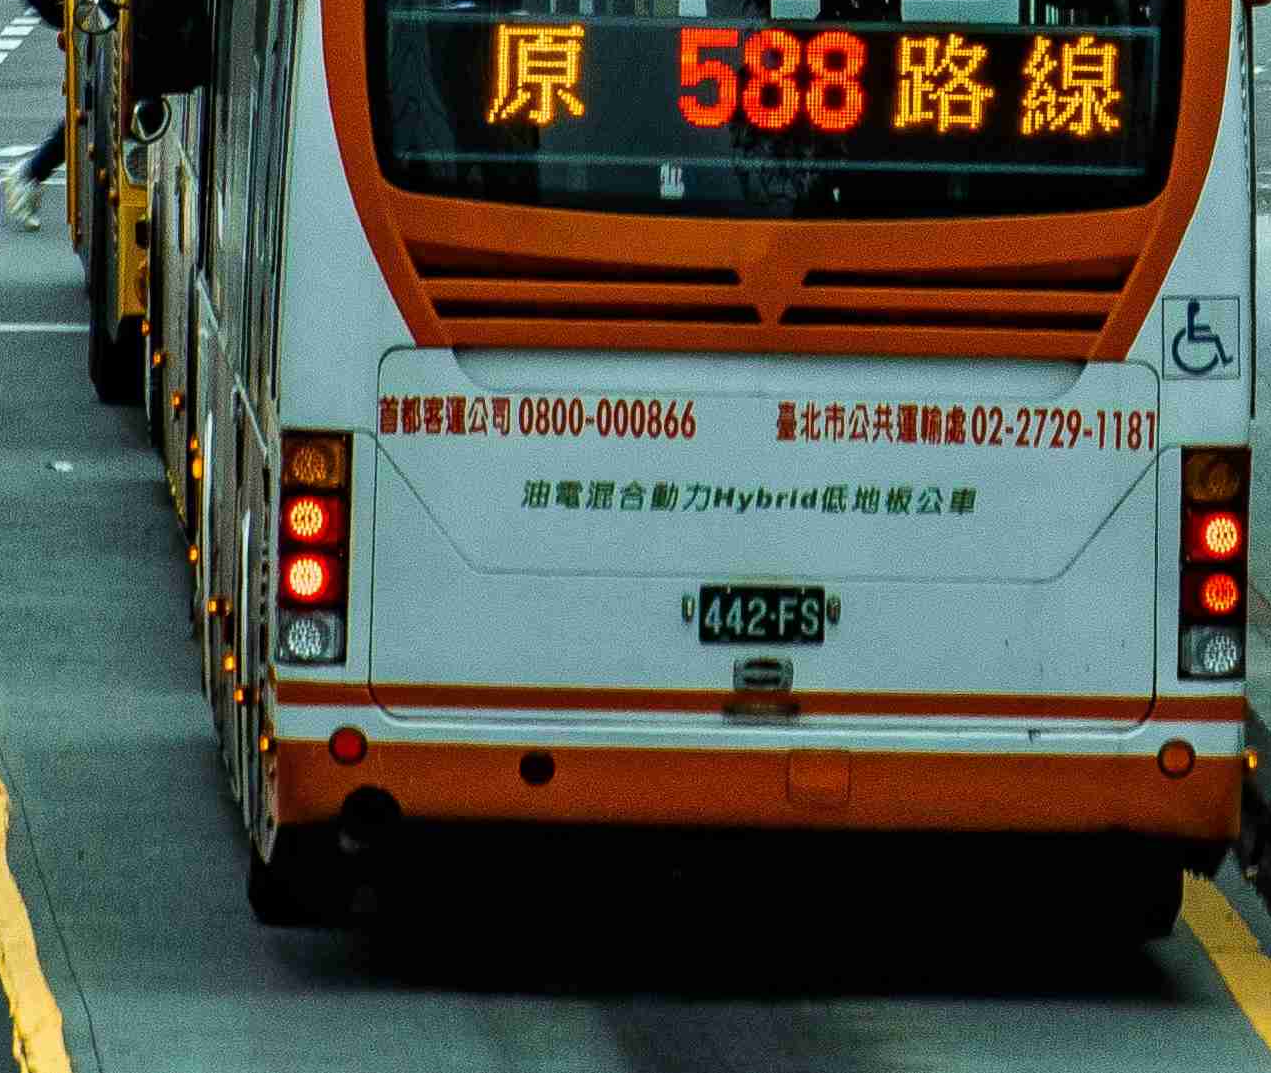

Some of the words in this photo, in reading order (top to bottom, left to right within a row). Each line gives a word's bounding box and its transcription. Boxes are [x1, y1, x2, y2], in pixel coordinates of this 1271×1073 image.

[488, 23, 585, 125] 原
[677, 27, 869, 130] 588
[894, 35, 1122, 137] 路線
[379, 395, 511, 437] 首都客運公司
[517, 397, 697, 440] 0800-000866
[970, 405, 1158, 450] 02-2729-1181
